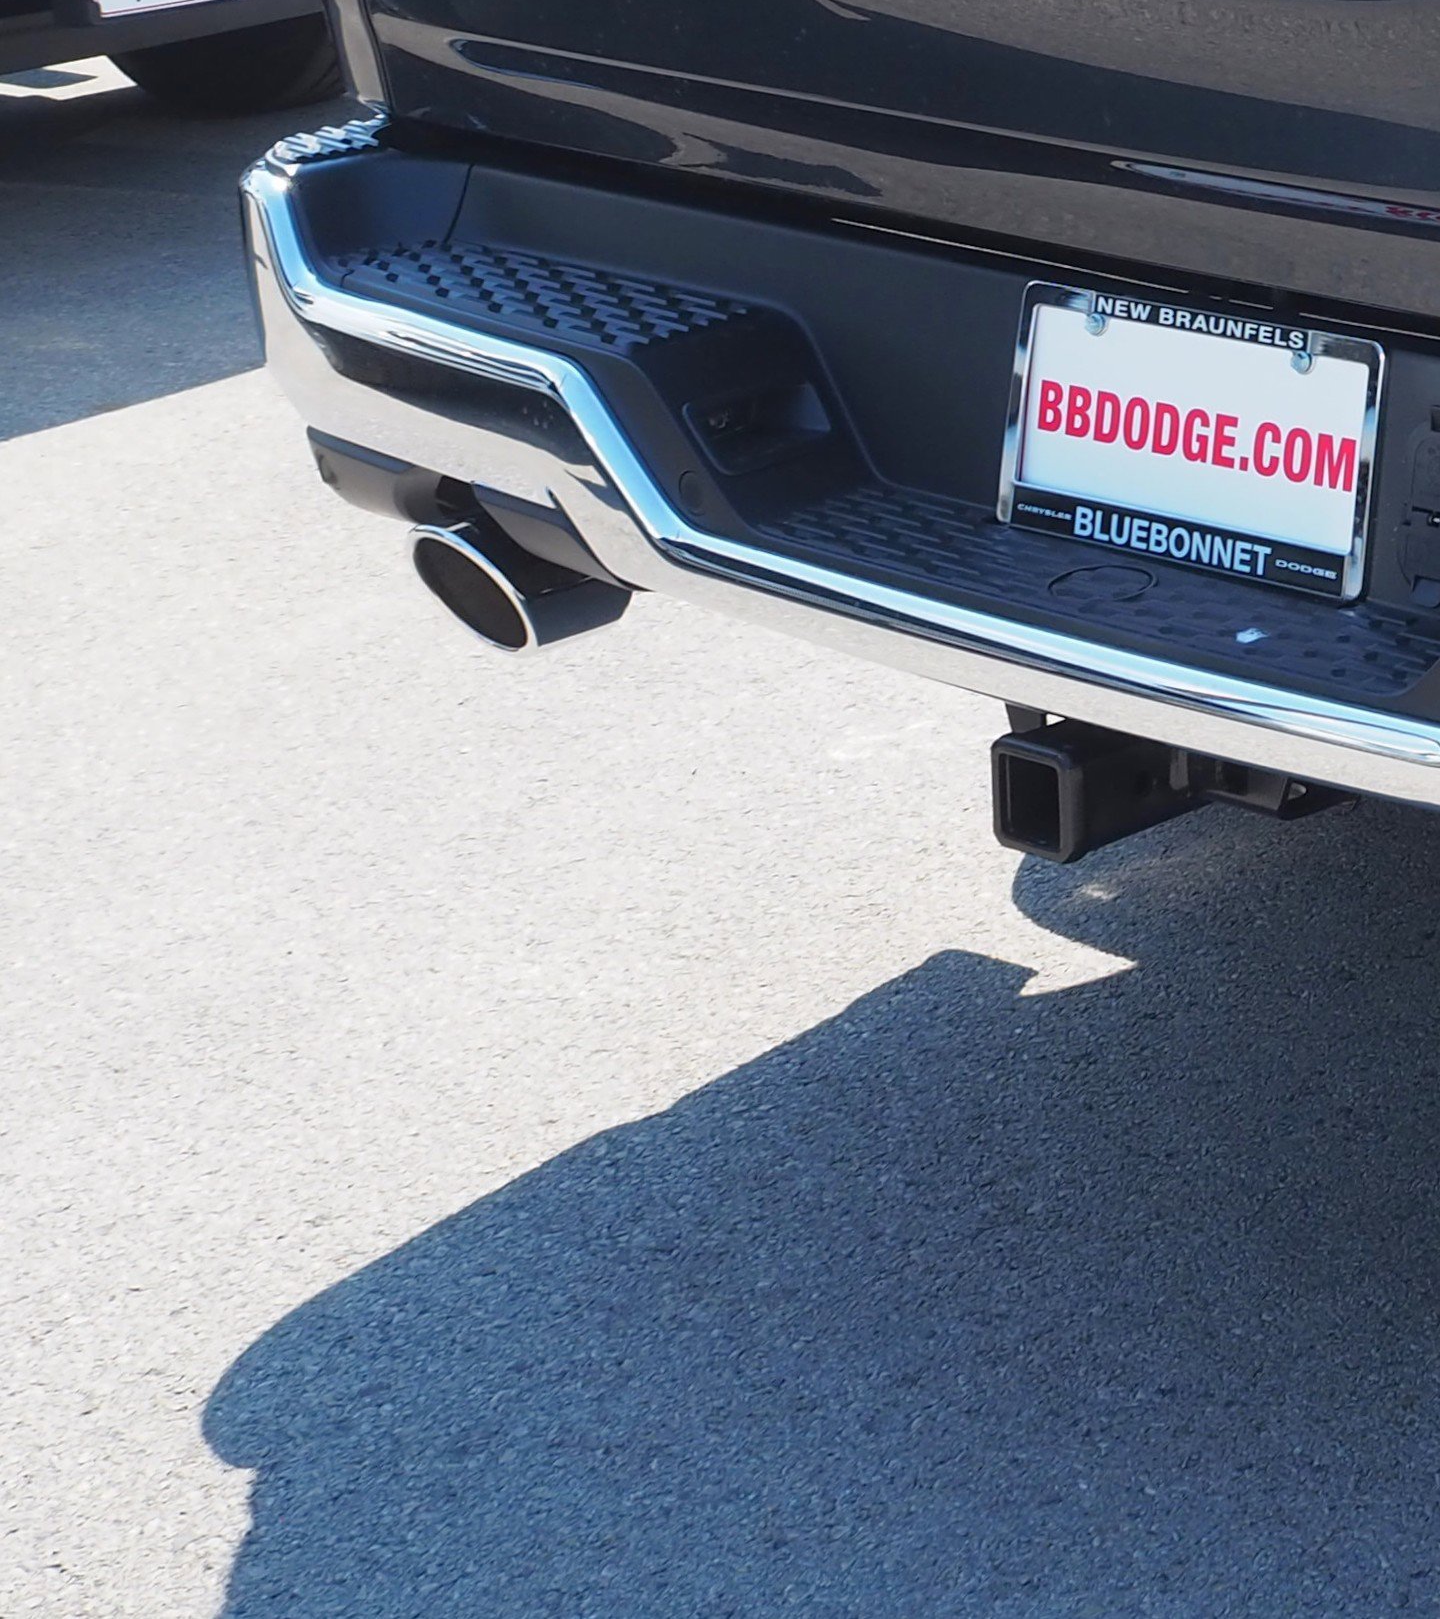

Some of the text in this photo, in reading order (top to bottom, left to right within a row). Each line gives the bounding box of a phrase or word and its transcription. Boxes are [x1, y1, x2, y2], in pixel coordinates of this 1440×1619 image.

[1096, 296, 1305, 350] NEW BRAUNFELS
[1037, 380, 1357, 493] BBDODGE.COM
[1016, 502, 1338, 580] CHRYSLER BLUEBONNET DODGE
